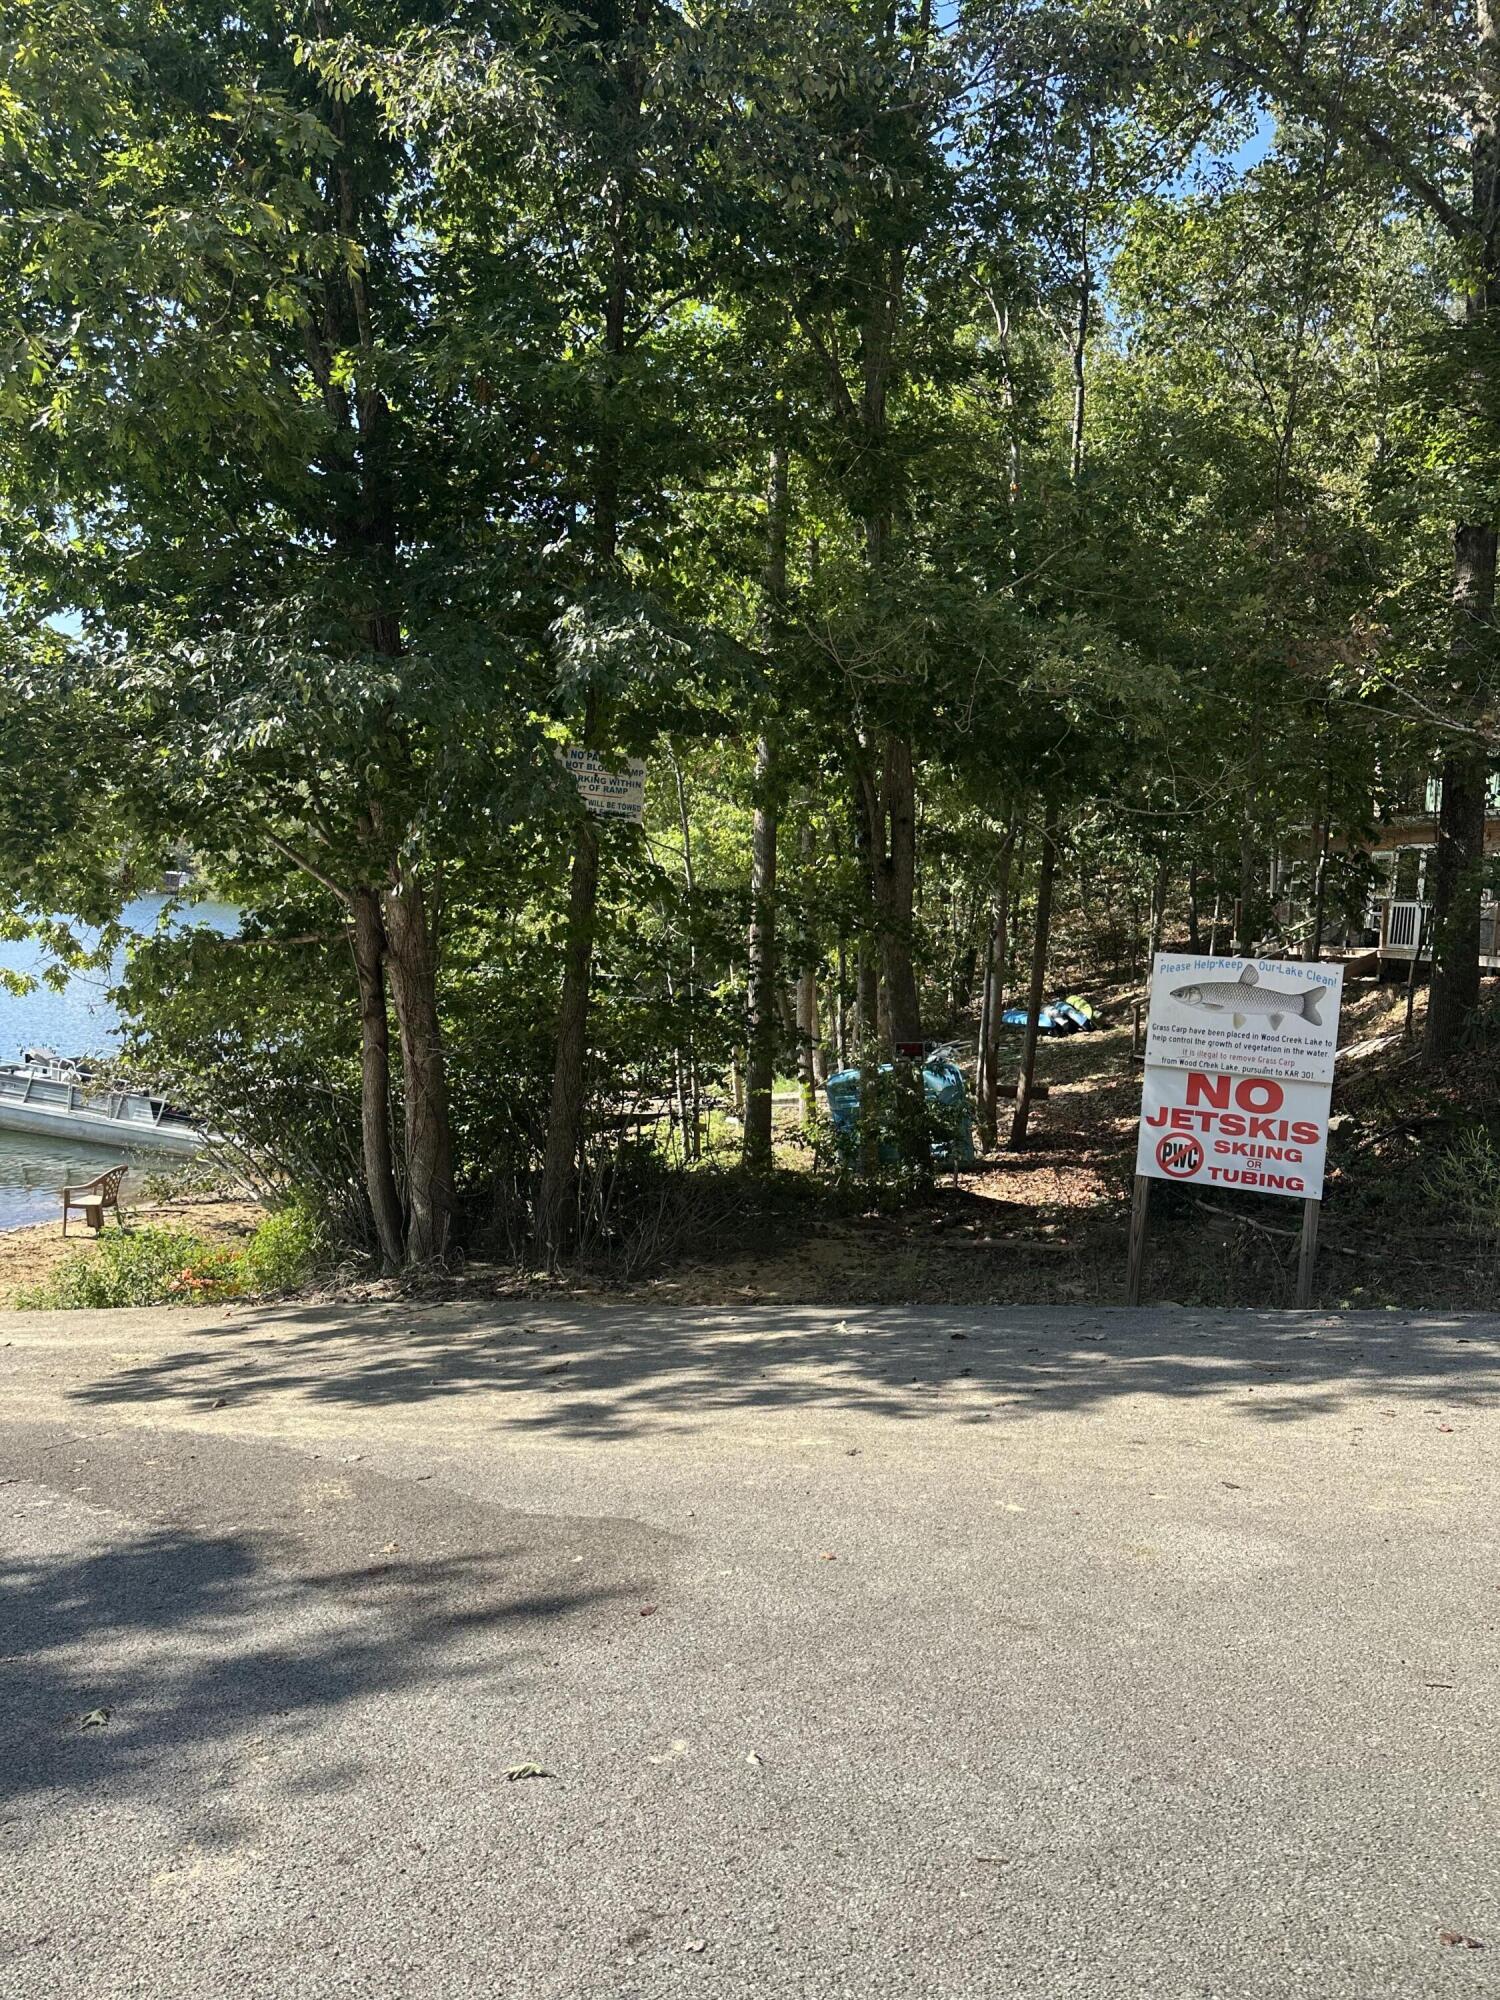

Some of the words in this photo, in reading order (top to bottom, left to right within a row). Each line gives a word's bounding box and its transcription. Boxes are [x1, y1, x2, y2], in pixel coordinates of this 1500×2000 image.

[566, 760, 584, 770] NOT
[571, 750, 584, 760] NO
[589, 784, 601, 792] OF
[603, 785, 629, 795] RAMP
[609, 778, 642, 788] WITHIN
[588, 799, 605, 808] WILL
[606, 801, 616, 809] BE
[618, 803, 642, 812] TOWED
[1160, 962, 1191, 974] Please
[1194, 959, 1216, 971] Help
[1218, 959, 1243, 972] Keep
[1258, 961, 1277, 973] Our
[1279, 963, 1304, 977] Lake
[1306, 970, 1337, 987] Clean!
[1152, 1023, 1170, 1031] Grass
[1171, 1025, 1187, 1034] Carp
[1189, 1027, 1206, 1035] have
[1207, 1029, 1225, 1037] been
[1226, 1030, 1250, 1039] placed
[1252, 1032, 1259, 1040] in
[1260, 1033, 1280, 1041] Wood
[1281, 1035, 1303, 1044] Creek
[1304, 1037, 1323, 1046] Lake
[1152, 1034, 1168, 1044] help
[1168, 1035, 1193, 1045] control
[1194, 1038, 1206, 1046] the
[1207, 1040, 1233, 1049] growth
[1234, 1041, 1242, 1049] of
[1243, 1043, 1282, 1053] vegetation
[1284, 1046, 1291, 1054] in
[1292, 1047, 1305, 1055] the
[1306, 1049, 1330, 1058] water.
[1161, 1056, 1178, 1065] from
[1179, 1058, 1198, 1067] Wood
[1198, 1060, 1219, 1069] Creek
[1241, 1066, 1274, 1076] pursuant
[1275, 1068, 1283, 1076] to
[1284, 1069, 1300, 1078] KAR
[1182, 1048, 1188, 1056] It
[1189, 1049, 1195, 1057] is
[1196, 1051, 1218, 1060] illegal
[1220, 1052, 1228, 1060] to
[1229, 1054, 1256, 1062] remove
[1257, 1056, 1277, 1065] Grass
[1278, 1058, 1296, 1068] Carp
[1185, 1072, 1284, 1115] NO
[1145, 1107, 1320, 1145] JETSKIS
[1162, 1142, 1198, 1170] PWC
[1214, 1139, 1303, 1163] SKIING
[1247, 1160, 1262, 1169] OR
[1207, 1166, 1305, 1192] TUBING
